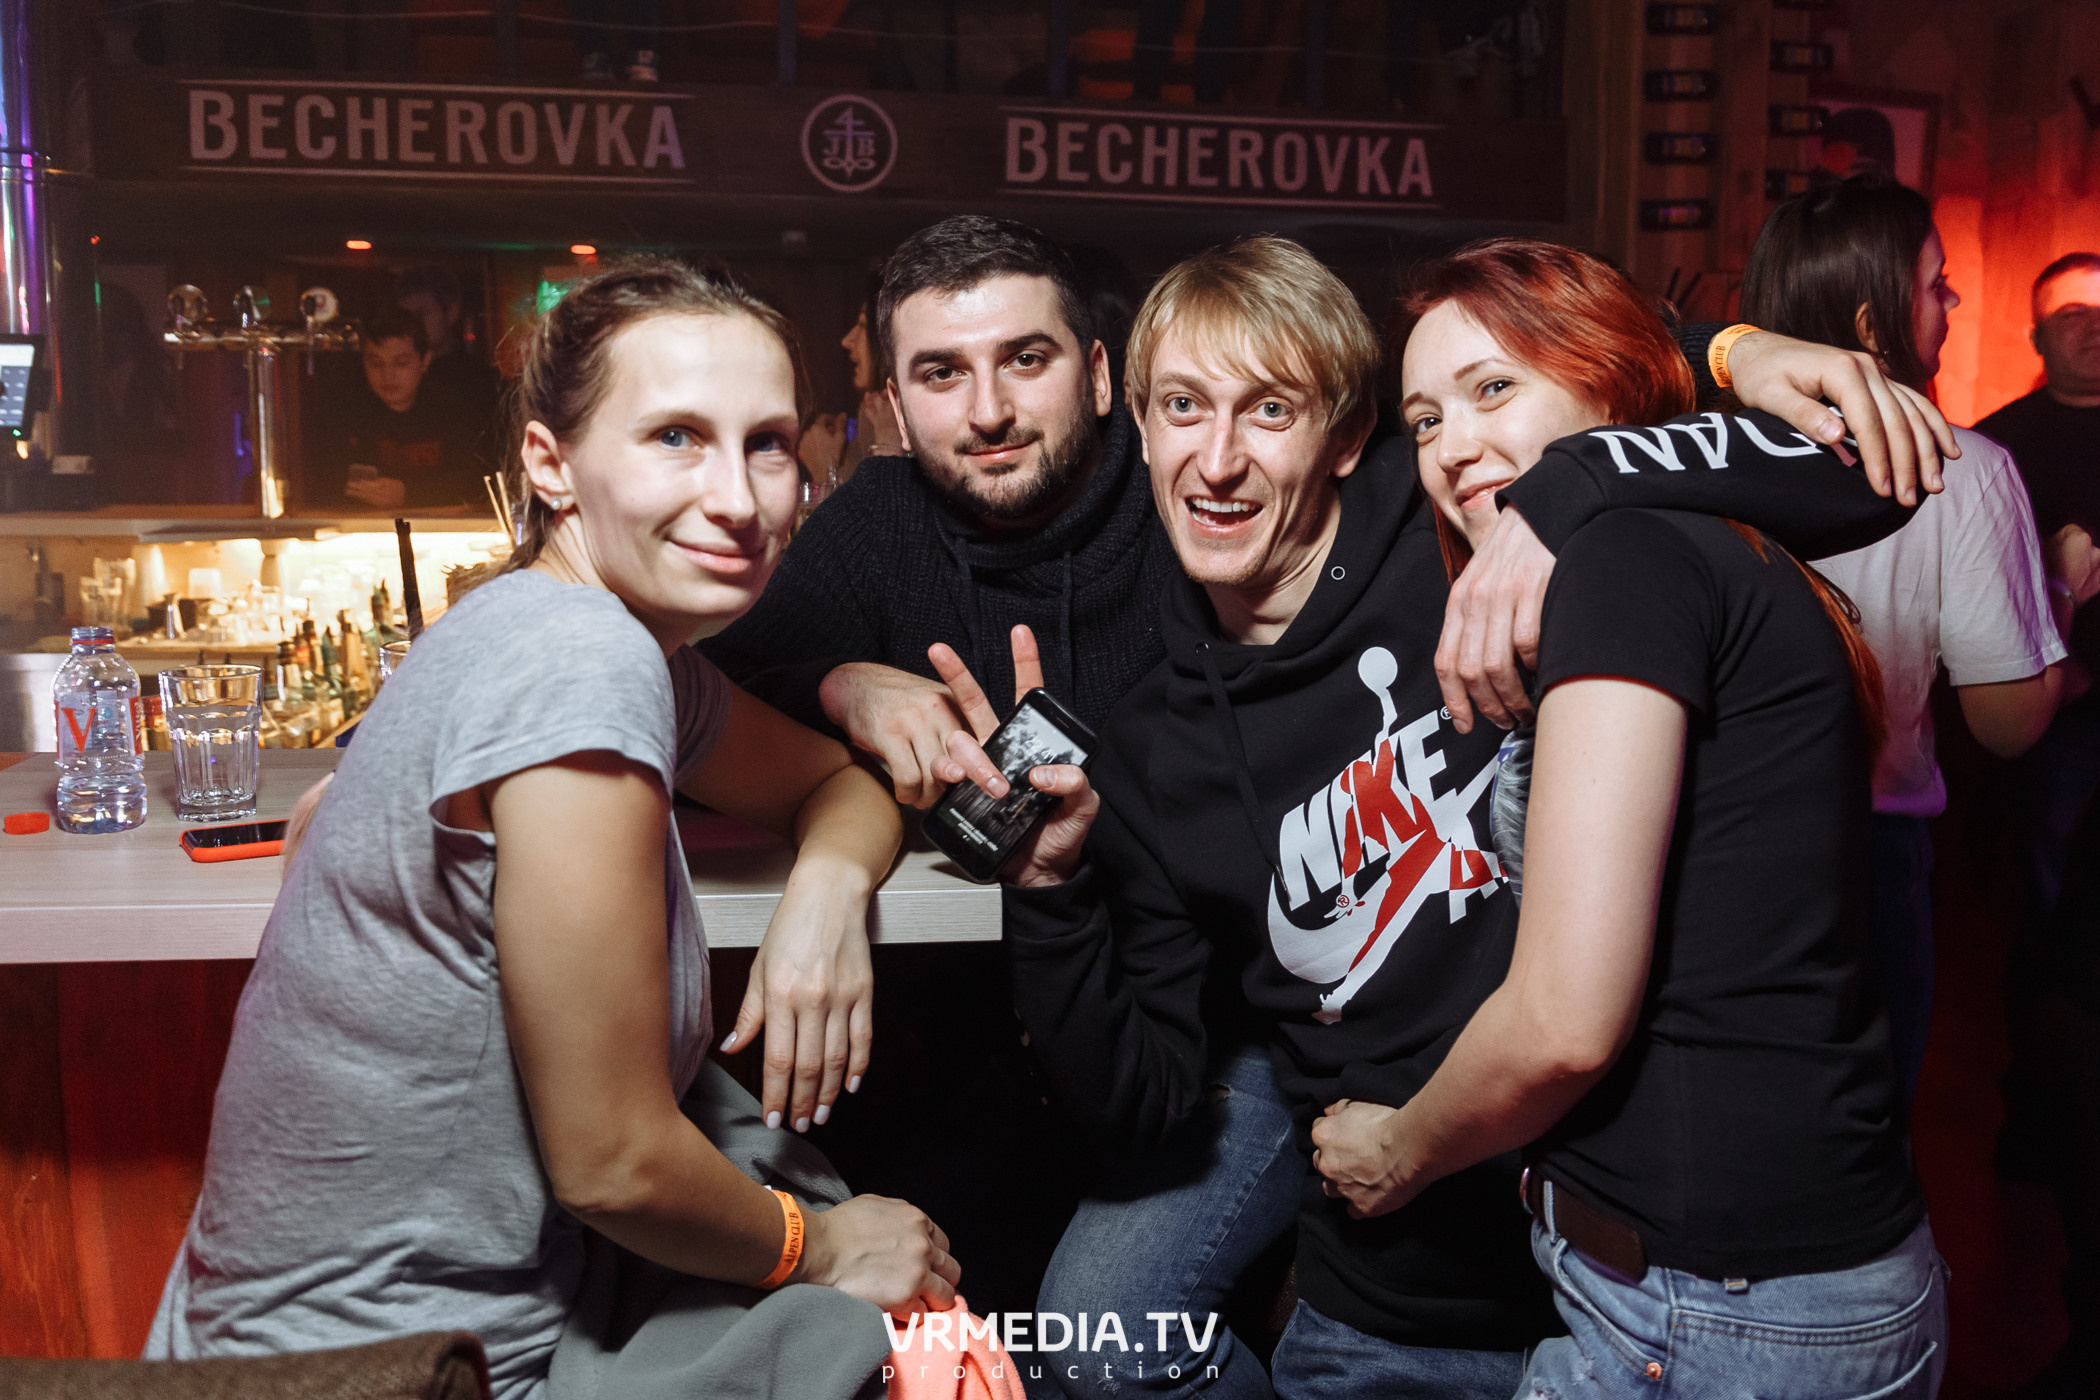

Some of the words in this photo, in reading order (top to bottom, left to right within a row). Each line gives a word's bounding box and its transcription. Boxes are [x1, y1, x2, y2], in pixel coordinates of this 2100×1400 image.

[189, 89, 686, 168] BECHEROVKA
[1006, 117, 1433, 195] BECHEROVKA
[1715, 345, 1726, 365] CLUB
[1280, 709, 1457, 912] NIKE
[788, 1212, 800, 1236] CLUB
[784, 1237, 799, 1264] ALPEN
